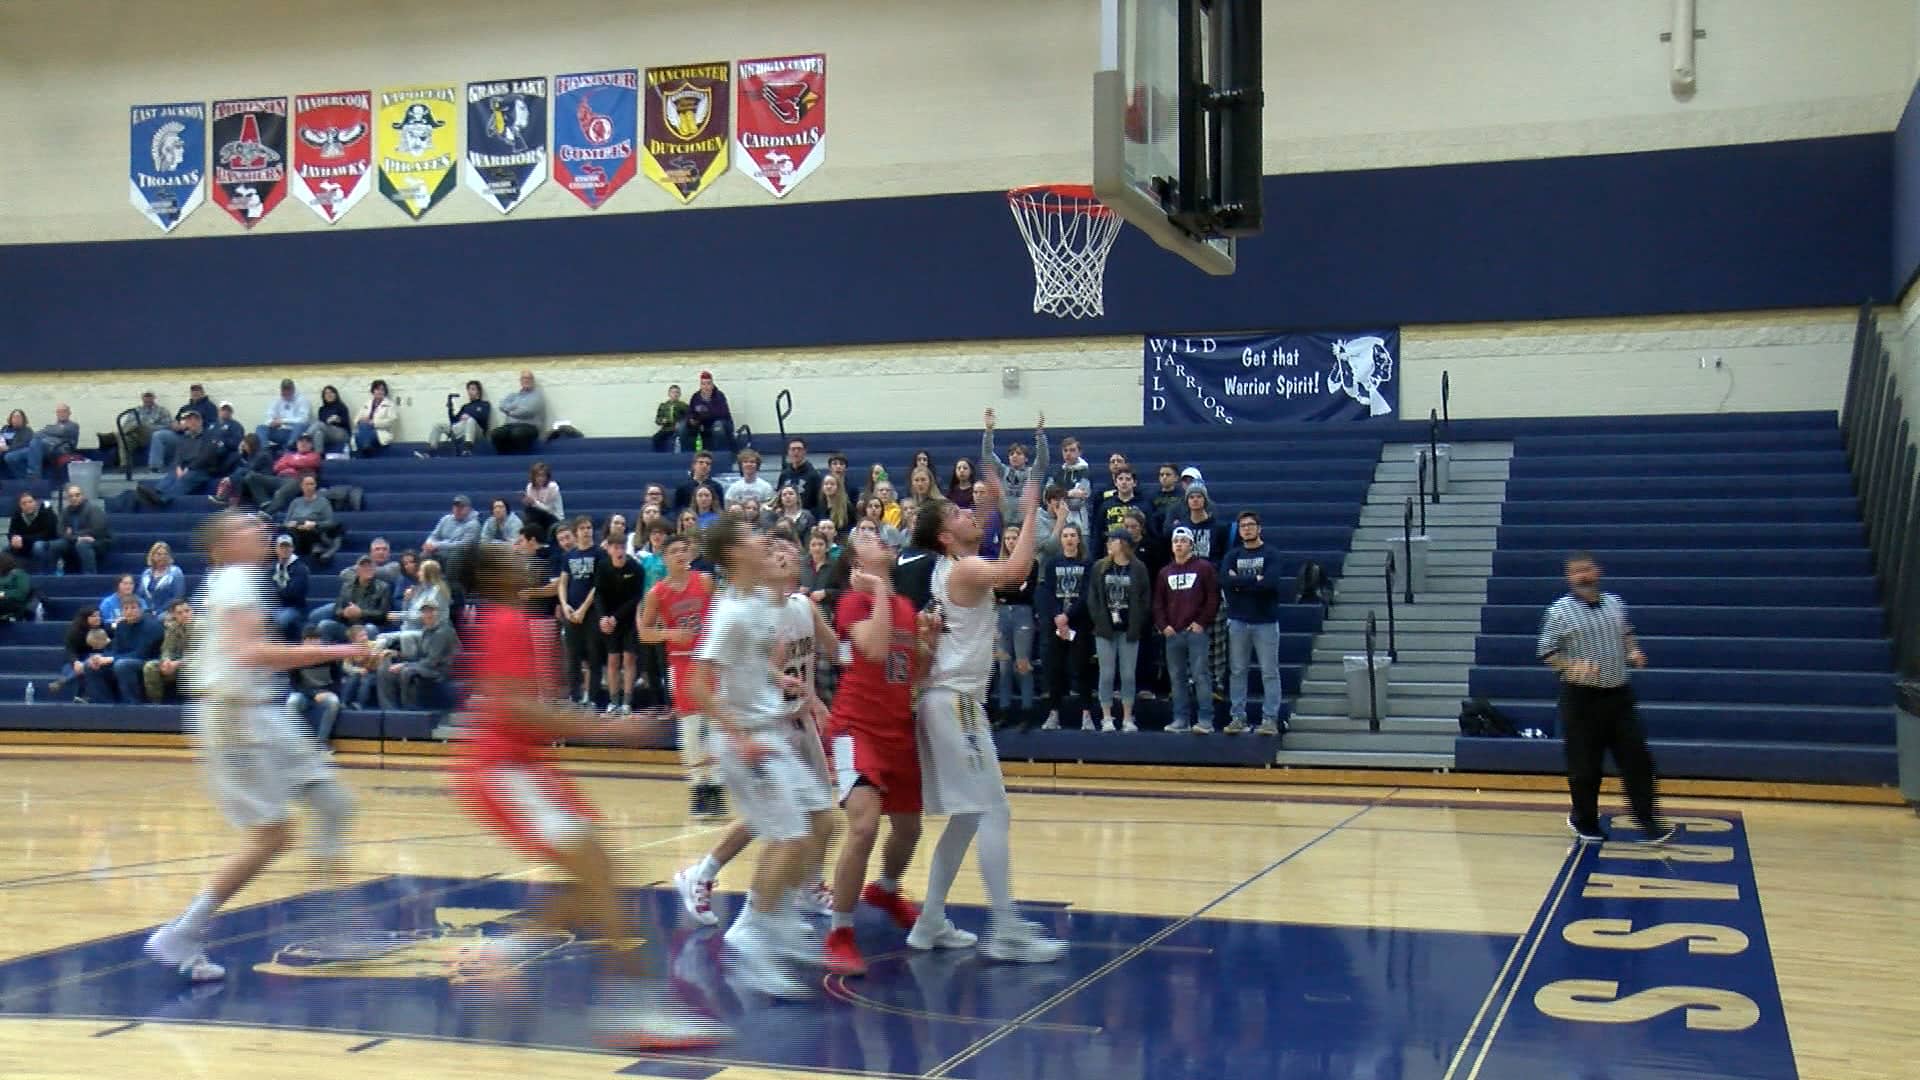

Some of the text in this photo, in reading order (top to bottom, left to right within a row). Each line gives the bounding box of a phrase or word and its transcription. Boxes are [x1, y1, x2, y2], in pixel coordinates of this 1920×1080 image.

[648, 66, 728, 83] MANCHESTER
[740, 58, 824, 79] MICHIGAN CENTER
[469, 79, 546, 103] GRASS LAKE
[555, 73, 637, 95] HANOVER
[133, 108, 157, 124] EAST
[651, 136, 723, 155] DUTCHMEN
[742, 127, 819, 149] CARDINALS
[470, 146, 545, 167] WARRIORS
[560, 139, 633, 161] COMETS
[302, 160, 367, 178] JAYHAWKS
[384, 153, 452, 173] PIRATES
[138, 169, 200, 188] TROJANS
[1149, 338, 1218, 354] WILD
[1242, 347, 1300, 368] Get that
[1224, 372, 1320, 399] Warrior Spirit!
